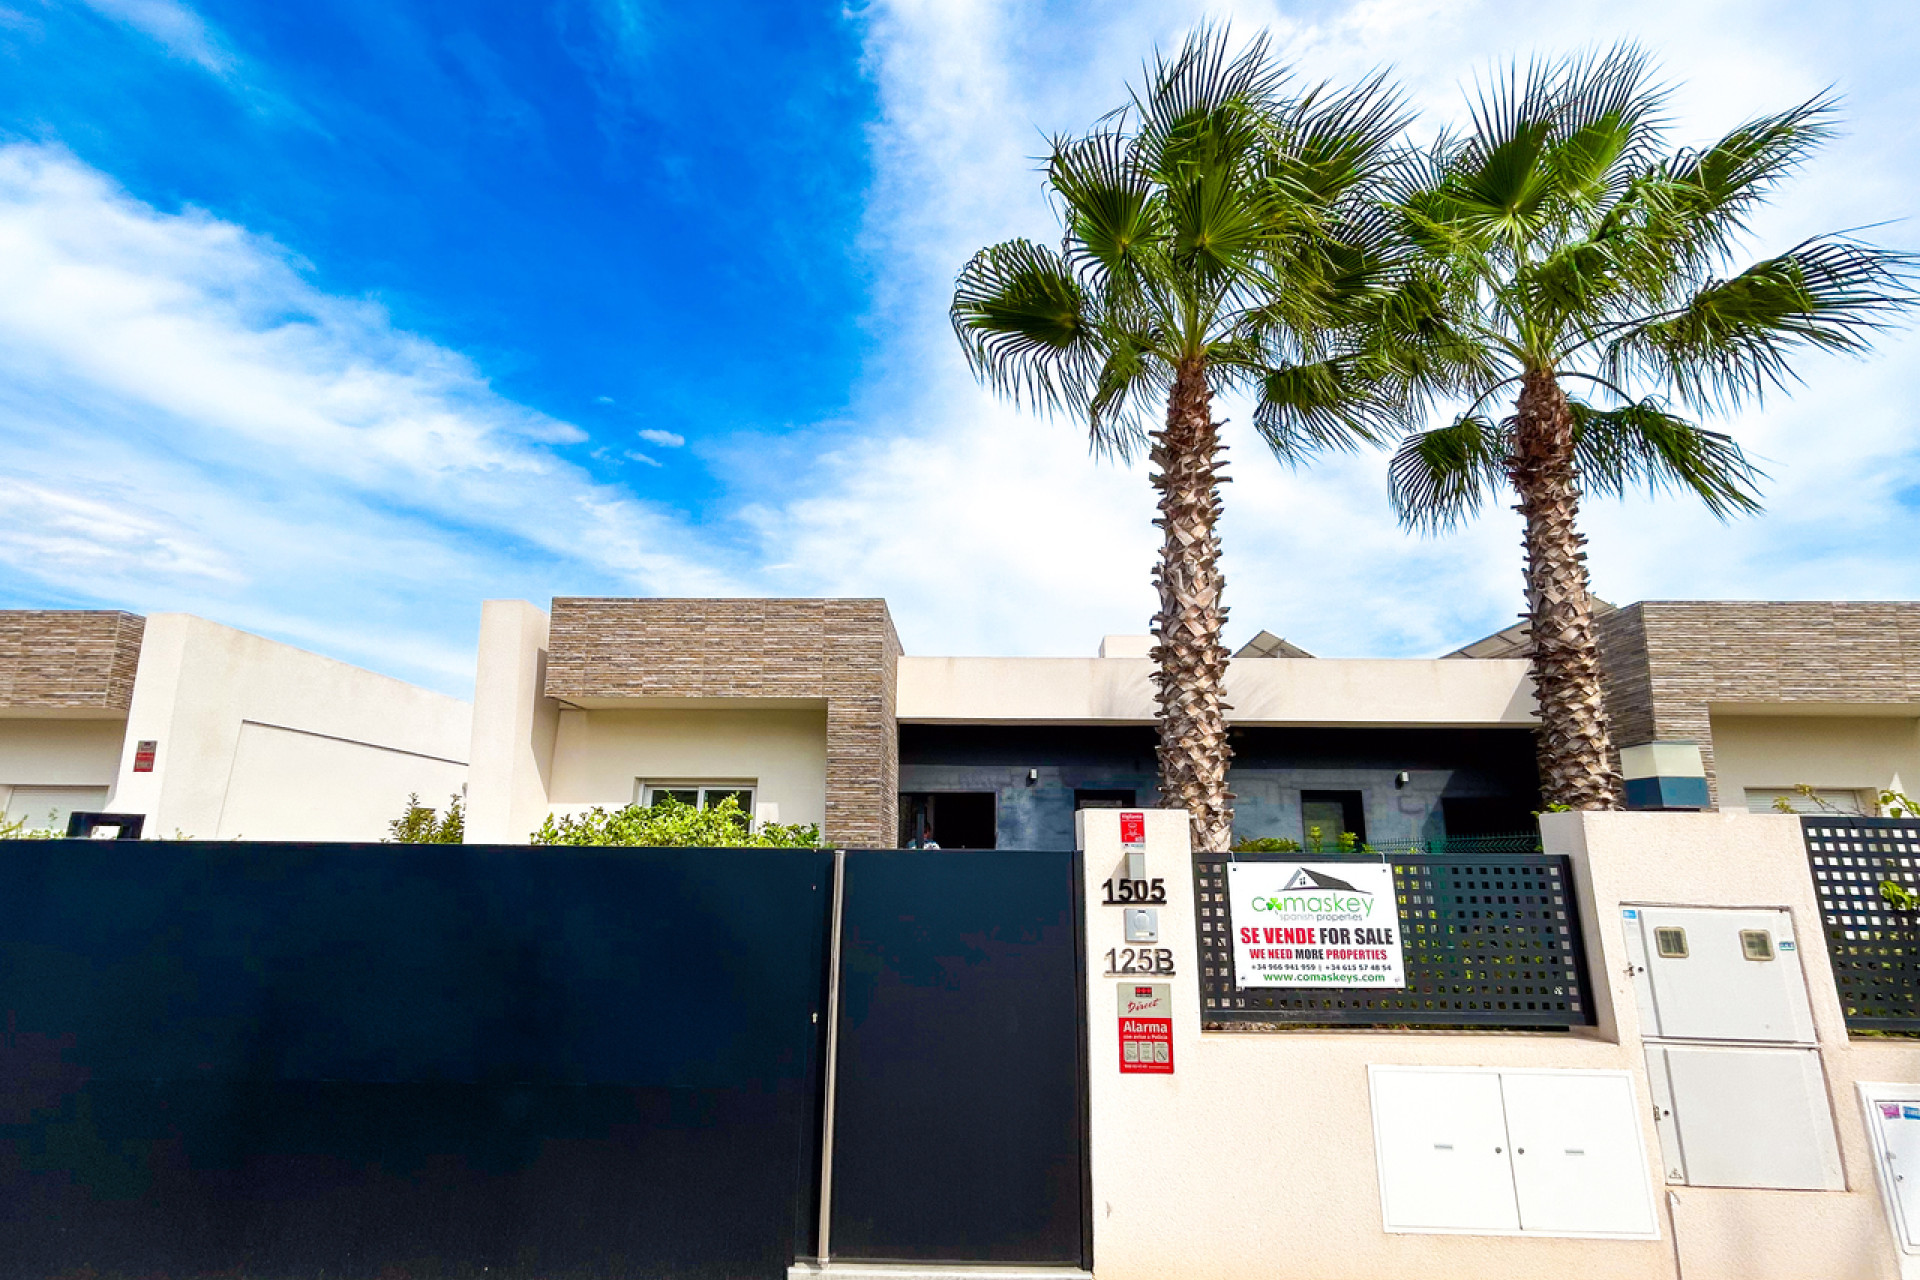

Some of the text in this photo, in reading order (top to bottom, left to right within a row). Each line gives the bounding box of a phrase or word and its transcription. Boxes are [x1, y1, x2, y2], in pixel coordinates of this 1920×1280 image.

[1101, 878, 1166, 902] 1505
[1251, 892, 1375, 917] comaskey
[1280, 912, 1363, 922] spanish properties
[1240, 927, 1394, 945] SE VENDE FOR SALE
[1104, 947, 1175, 973] 125B
[1249, 948, 1388, 960] WE NEED MORE PROPERTIES
[1263, 972, 1386, 984] www.comaskeys.com
[1123, 1020, 1168, 1033] Alarma
